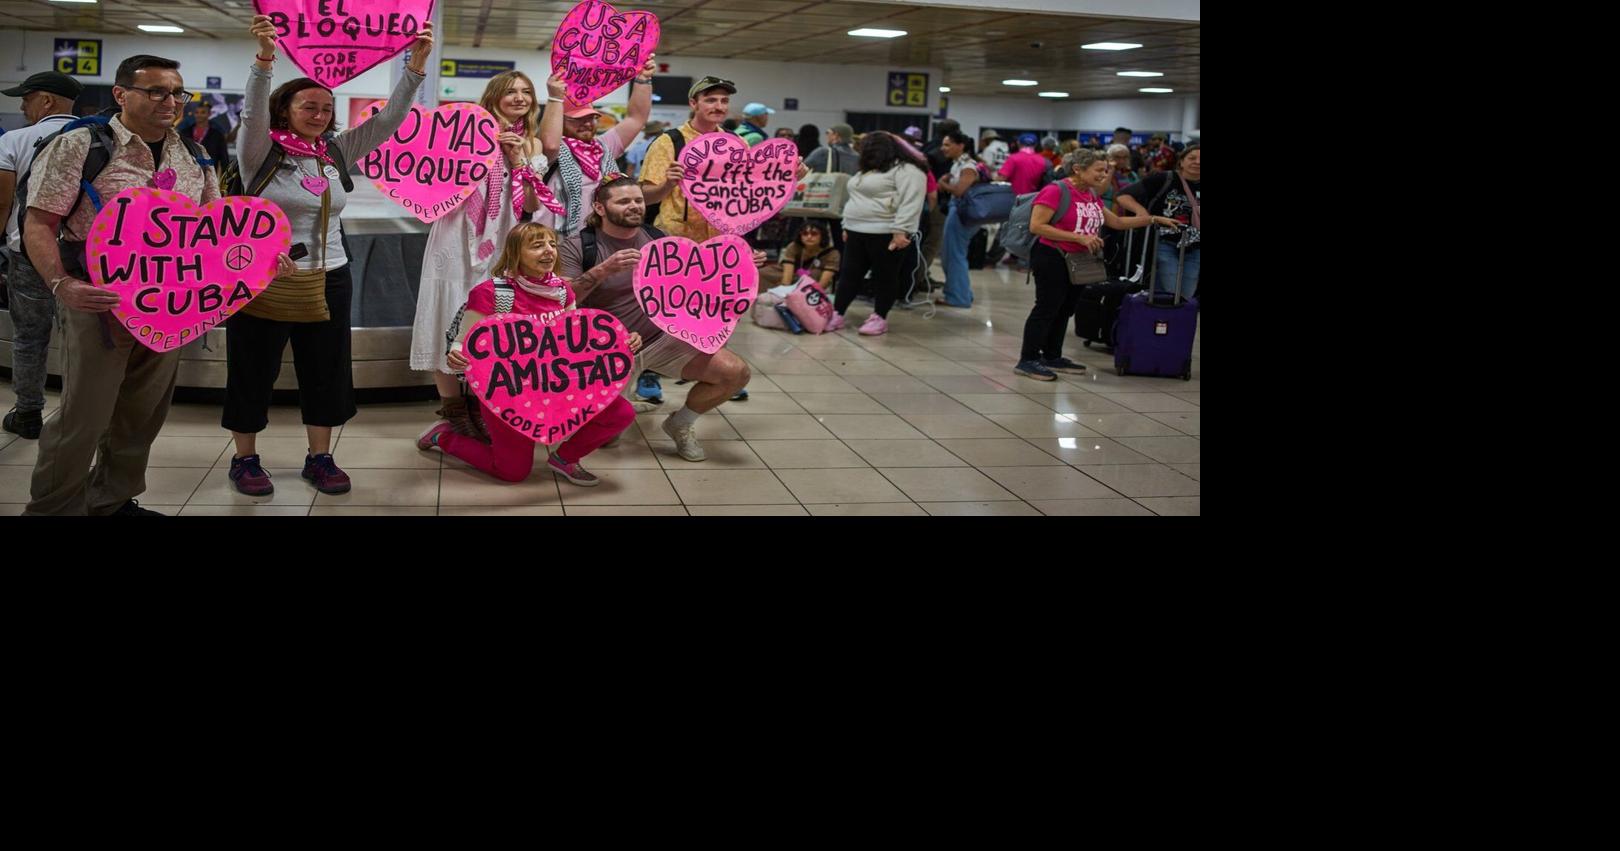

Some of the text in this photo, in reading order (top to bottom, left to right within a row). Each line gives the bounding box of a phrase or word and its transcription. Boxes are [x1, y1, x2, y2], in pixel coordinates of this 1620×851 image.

[319, 0, 348, 17] EL
[581, 1, 647, 42] USA
[312, 51, 357, 65] CODE
[559, 27, 640, 65] CUBA
[57, 56, 92, 74] C 4
[314, 66, 356, 80] PINK
[555, 51, 636, 87] AMISTAD
[371, 106, 496, 156] O MAS
[364, 148, 488, 186] BLOQUEO
[702, 160, 793, 184] Lift the
[389, 188, 463, 218] CODEPINK
[690, 182, 786, 203] Sanctions
[706, 196, 773, 217] on CUBA
[108, 197, 276, 249] I STAND
[100, 253, 203, 285] WITH
[644, 241, 739, 281] ABAJO
[135, 280, 253, 315] CUBA
[721, 273, 750, 295] EL
[640, 284, 750, 322] BLOQUEO
[126, 310, 230, 349] CODEPINK
[467, 314, 619, 361] CUBA-U.S.
[667, 324, 731, 348] CODEPINK
[485, 352, 632, 400] AMISTAD
[501, 404, 595, 443] CODE PINK
